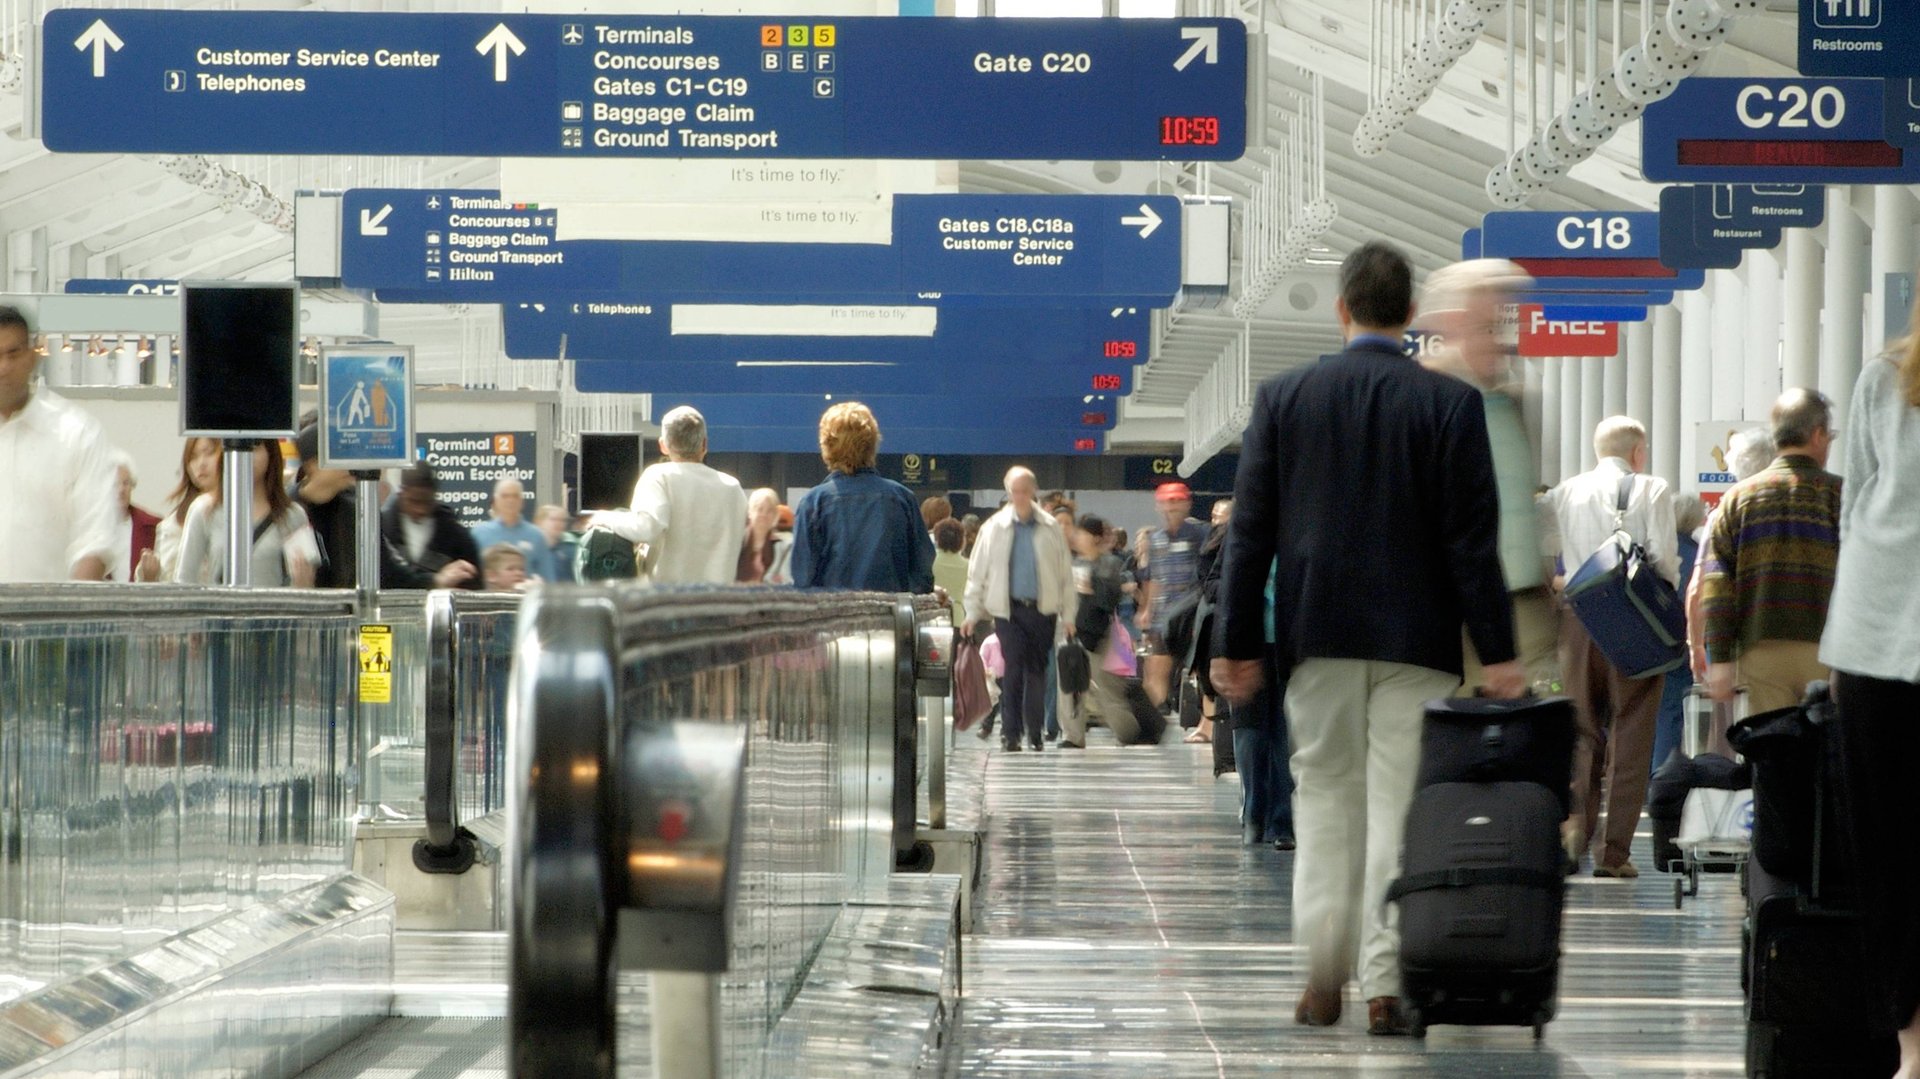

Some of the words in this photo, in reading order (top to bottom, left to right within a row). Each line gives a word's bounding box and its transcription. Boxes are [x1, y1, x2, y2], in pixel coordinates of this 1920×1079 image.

[594, 25, 694, 44] Terminals
[766, 28, 777, 43] 2
[793, 28, 803, 43] 3
[819, 28, 830, 43] 5
[1812, 38, 1884, 51] Restrooms
[196, 48, 291, 66] Customer
[297, 49, 369, 67] Service
[374, 49, 441, 67] Center
[593, 50, 720, 70] Concourses
[765, 54, 778, 69] B
[792, 54, 804, 69] E
[818, 54, 830, 69] F
[974, 52, 1032, 73] Gate
[1042, 53, 1092, 73] C20
[196, 73, 306, 94] Telephones
[593, 77, 656, 96] Gates
[666, 78, 748, 96] C1-C19
[816, 79, 831, 95] C
[1736, 84, 1846, 129] C20
[593, 103, 686, 125] Baggage
[696, 103, 754, 122] Claim
[1162, 117, 1219, 145] 10:59
[593, 129, 669, 147] Ground
[678, 129, 778, 150] Transport
[731, 168, 754, 182] It's
[760, 168, 794, 182] time
[800, 168, 815, 182] to
[450, 196, 513, 210] Terminals
[761, 210, 782, 222] It's
[786, 210, 817, 222] time
[822, 211, 836, 222] to
[1752, 206, 1804, 216] Restrooms
[449, 214, 530, 228] Concourses
[939, 218, 990, 233] Gates
[996, 218, 1074, 235] C18,C18a
[449, 232, 509, 248] Baggage
[511, 233, 548, 246] Claim
[1557, 216, 1631, 250] C18
[1713, 229, 1762, 238] Restaurant
[943, 237, 1014, 250] Customer
[1019, 237, 1074, 251] Service
[449, 250, 498, 263] Ground
[500, 251, 563, 266] Transport
[1013, 252, 1063, 266] Center
[449, 268, 494, 281] Hilton
[588, 303, 652, 315] Telephones
[831, 308, 847, 318] It's
[851, 308, 875, 318] time
[879, 309, 890, 319] to
[1104, 341, 1136, 357] 10:59
[1401, 334, 1445, 357] C16
[428, 438, 490, 451] Terminal
[499, 437, 509, 451] 2
[426, 453, 517, 466] Concourse
[1152, 459, 1173, 474] C2
[433, 470, 464, 480] own
[470, 468, 535, 480] Escalator
[434, 491, 488, 503] aggage
[462, 506, 484, 515] Side
